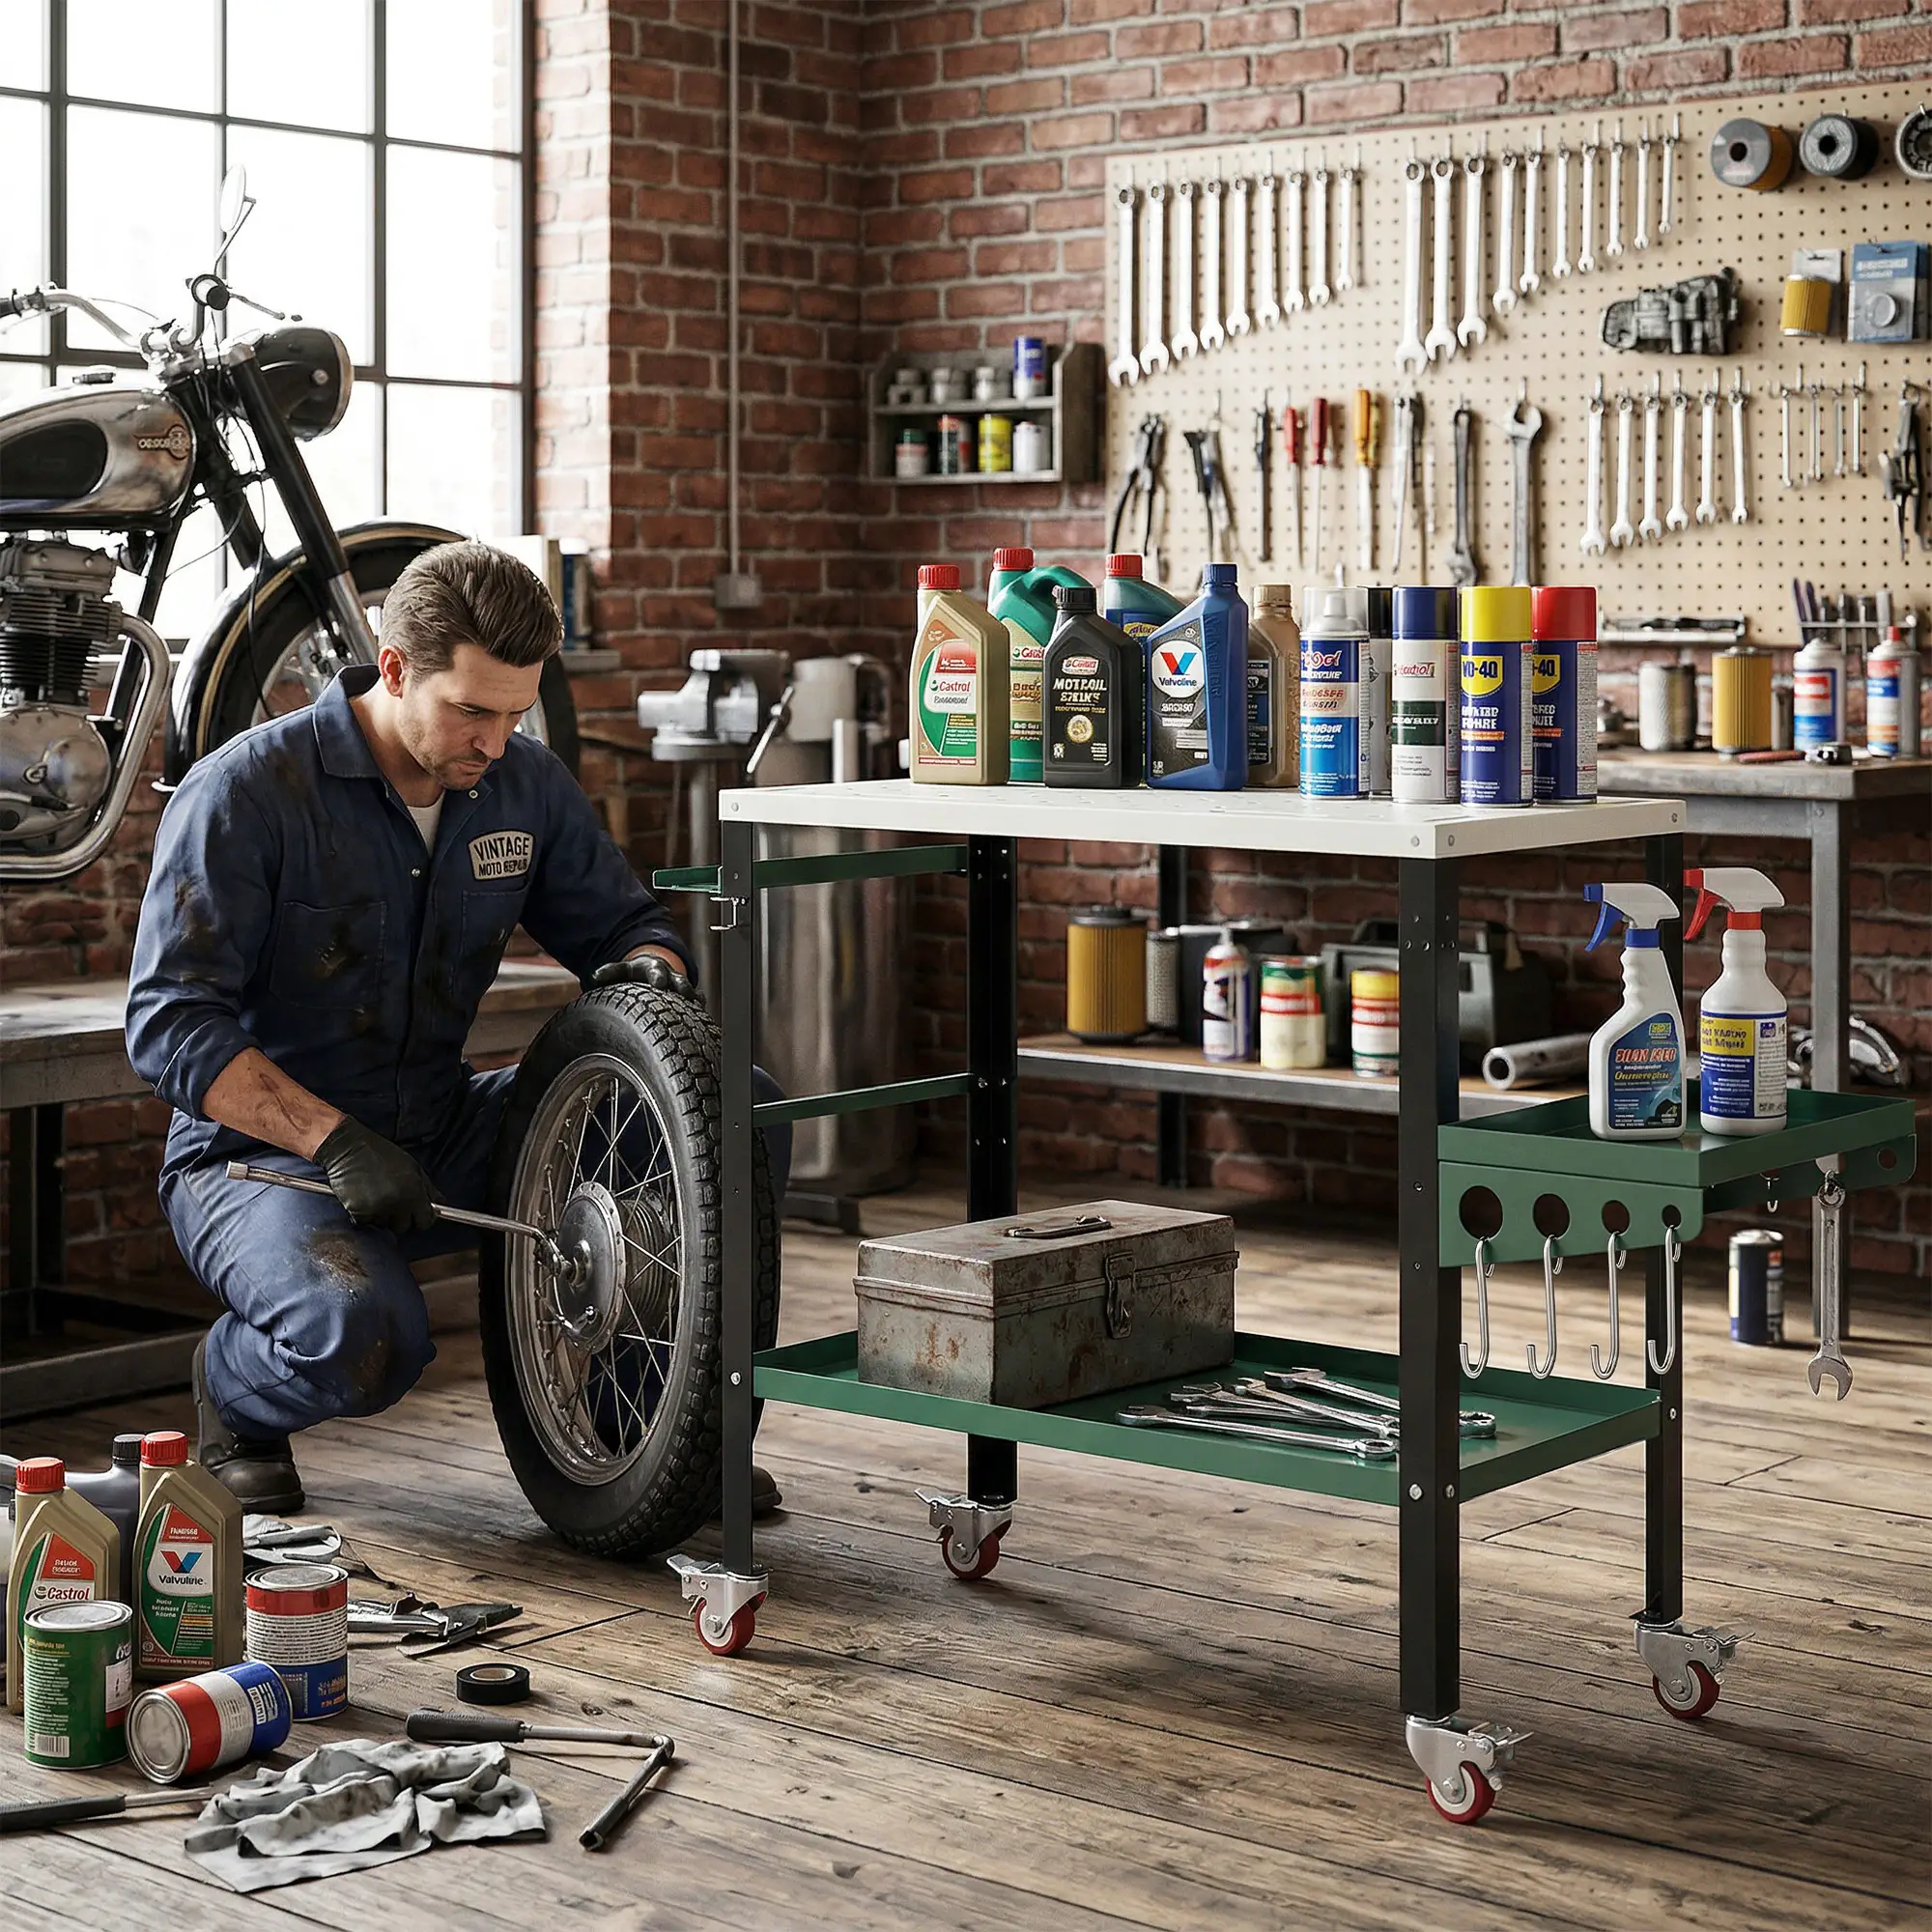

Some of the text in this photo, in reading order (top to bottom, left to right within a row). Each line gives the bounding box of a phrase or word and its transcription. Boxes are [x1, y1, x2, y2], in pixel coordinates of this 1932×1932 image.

[473, 837, 529, 861] VINTAGE
[478, 861, 502, 876] MOTO
[47, 1586, 90, 1601] Castrol
